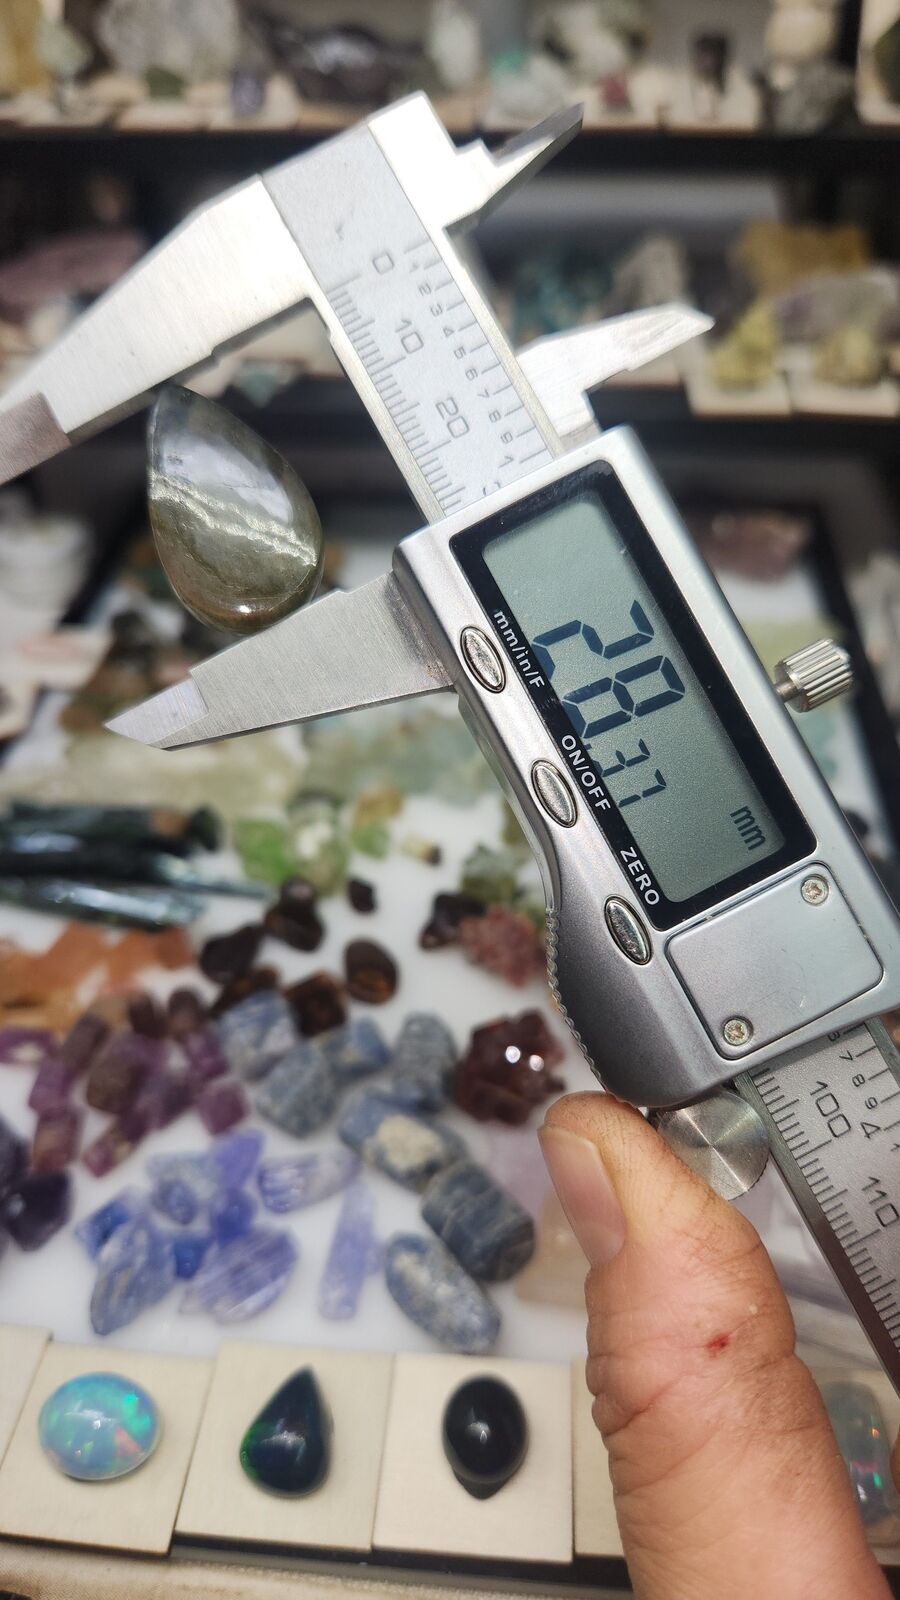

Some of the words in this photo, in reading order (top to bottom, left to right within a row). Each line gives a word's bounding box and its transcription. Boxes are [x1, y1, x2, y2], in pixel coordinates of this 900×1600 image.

[371, 251, 394, 275] 0
[395, 318, 424, 355] 10
[436, 397, 470, 439] 20
[418, 283, 432, 297] 2
[430, 304, 443, 317] 3
[443, 326, 454, 338] 4
[454, 346, 467, 360] 5
[466, 368, 478, 381] 6
[477, 389, 490, 399] 7
[489, 410, 502, 423] 8
[500, 431, 513, 444] 9
[493, 610, 545, 690] mm/in/F
[561, 735, 611, 810] ON/OFF
[730, 805, 767, 851] mm
[620, 846, 660, 906] ZERO
[839, 1049, 854, 1061] 7
[852, 1073, 866, 1088] 8
[860, 1121, 881, 1139] 4
[864, 1096, 878, 1109] 9
[810, 1080, 851, 1138] 100
[861, 1176, 899, 1227] 110
